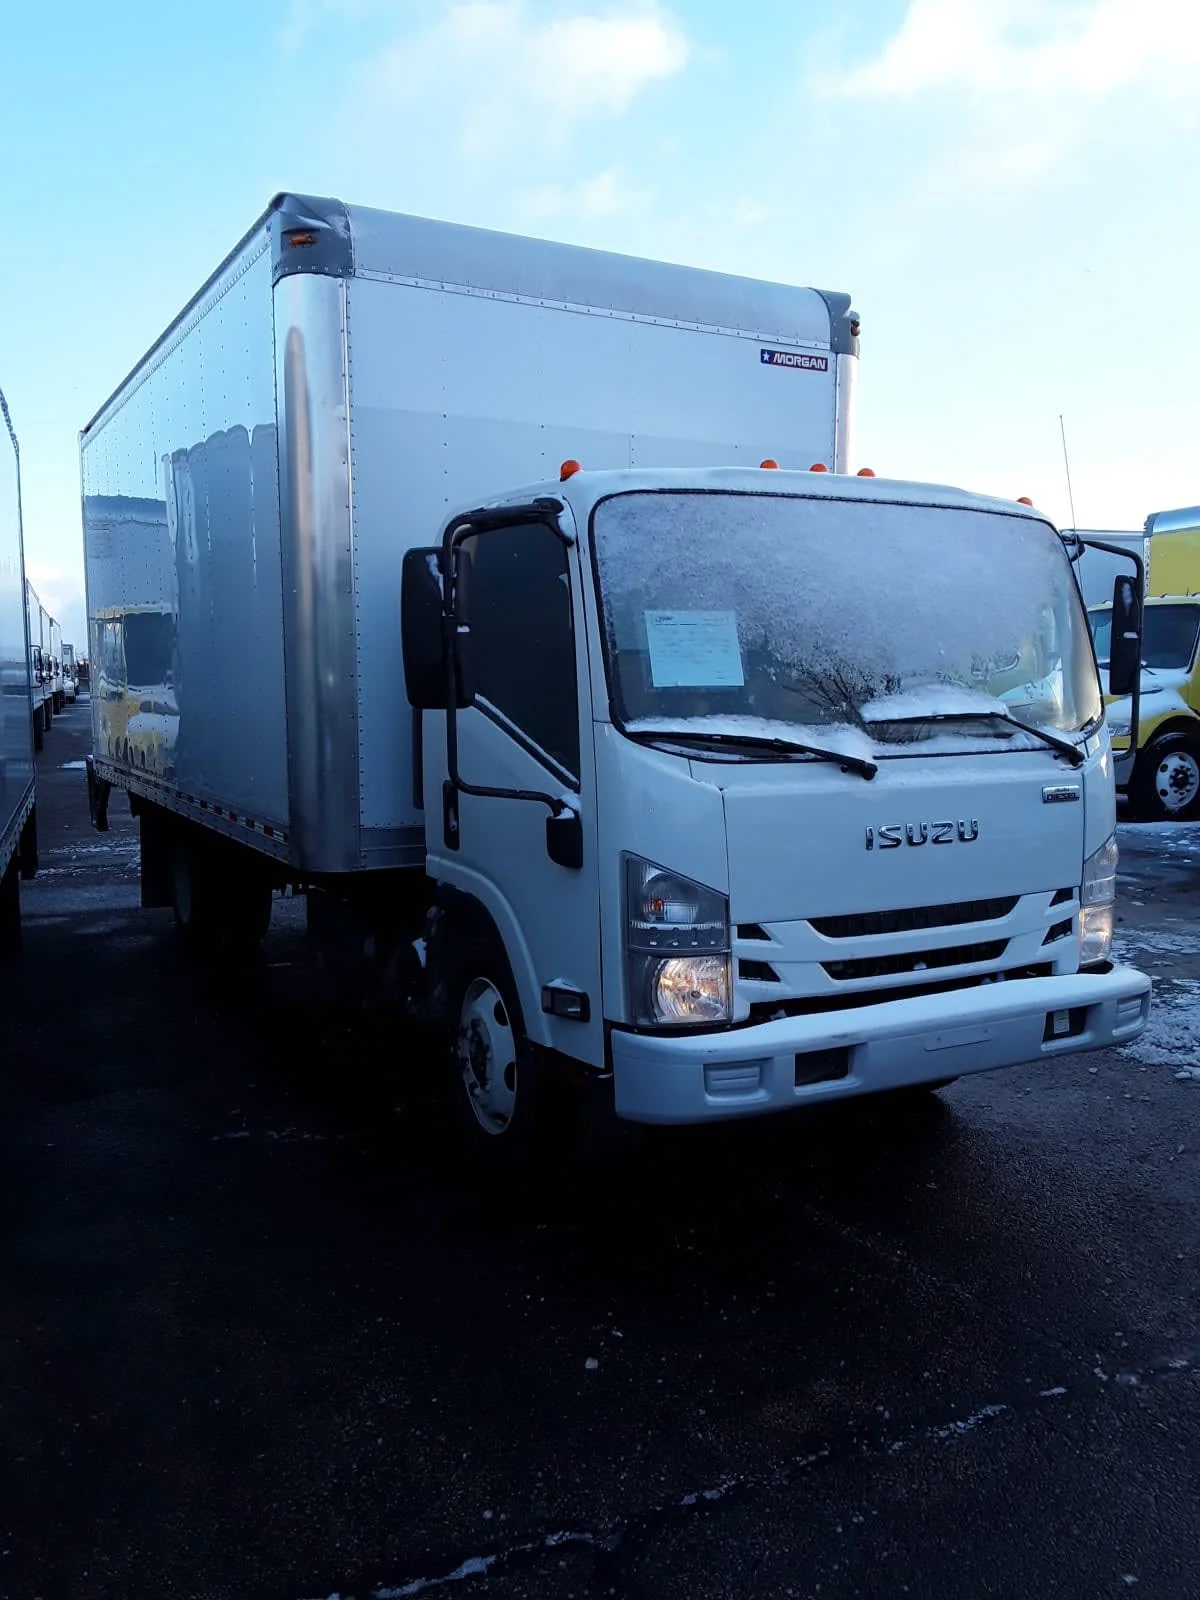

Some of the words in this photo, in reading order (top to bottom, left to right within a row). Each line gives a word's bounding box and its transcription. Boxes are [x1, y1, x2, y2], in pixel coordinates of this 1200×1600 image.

[773, 352, 827, 370] MORGAN
[1046, 792, 1080, 801] DIESEL
[865, 818, 979, 851] ISUZU
